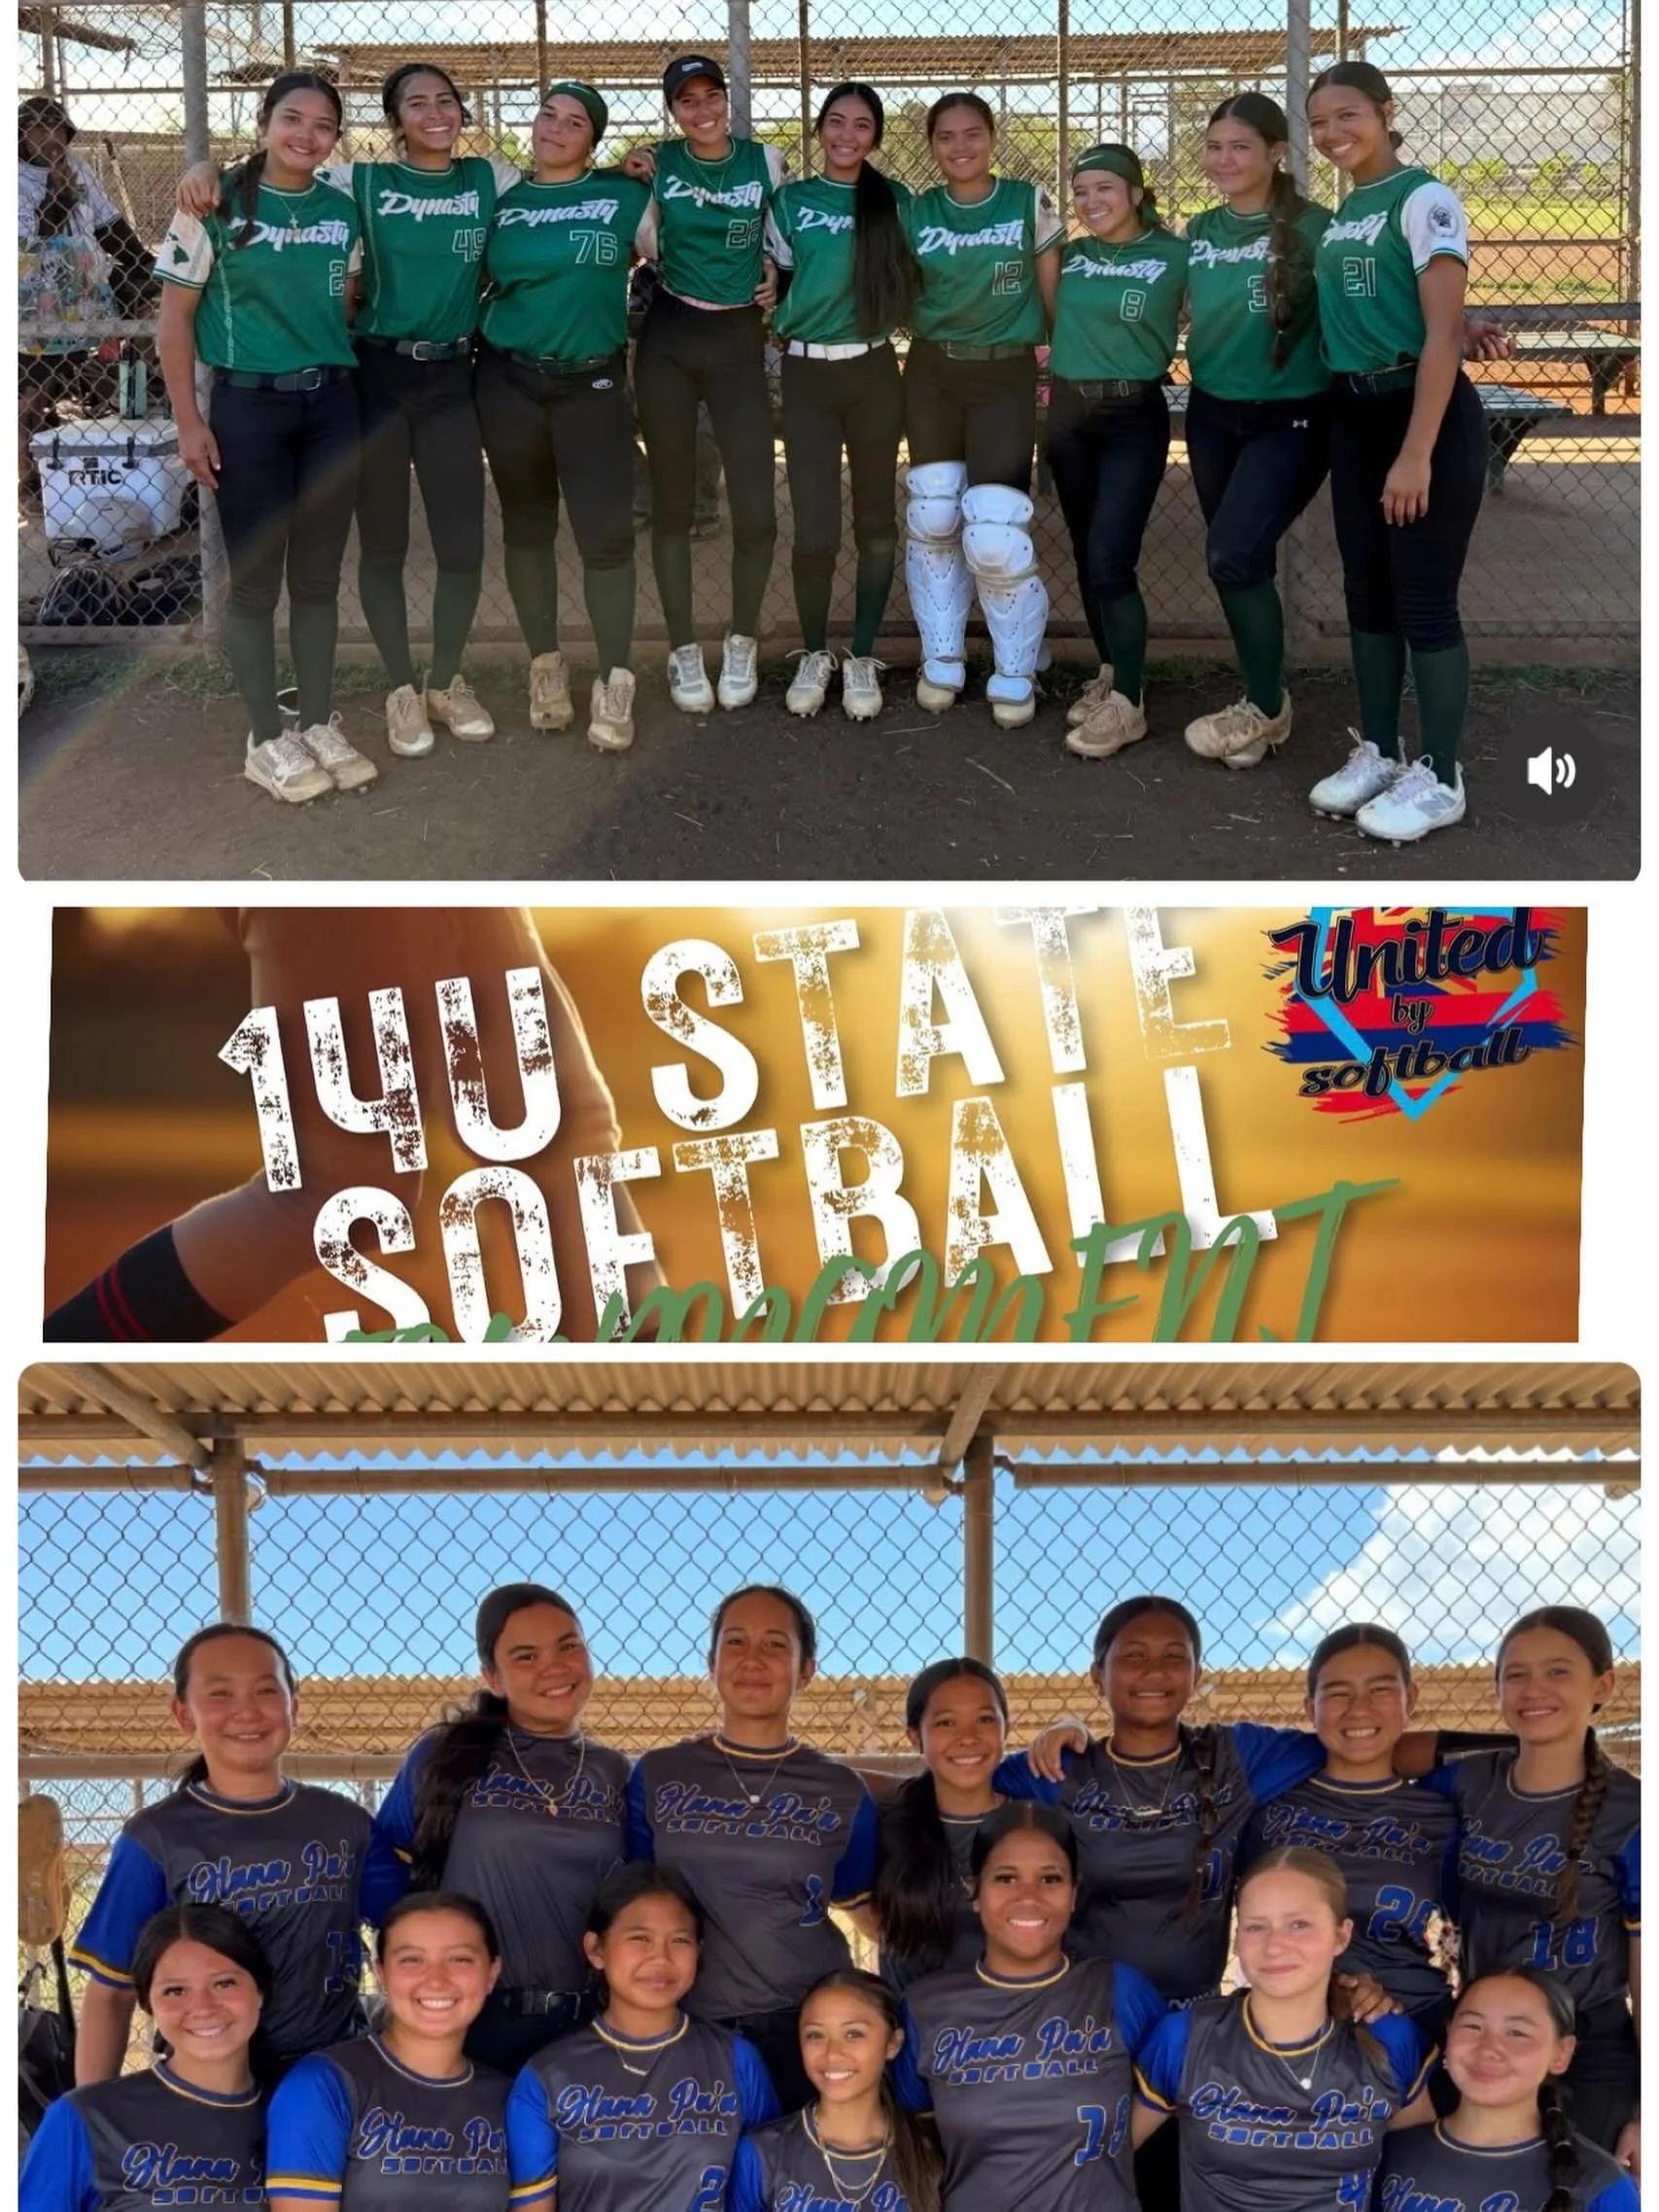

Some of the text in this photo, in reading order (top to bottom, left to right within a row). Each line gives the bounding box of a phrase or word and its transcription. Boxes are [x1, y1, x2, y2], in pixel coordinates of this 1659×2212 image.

[377, 189, 480, 223] Dynasty
[664, 175, 763, 210] Dynasty
[494, 198, 620, 228] Dynasty
[227, 217, 350, 252] Dynasty
[570, 229, 618, 266] 76
[917, 219, 1025, 257] Dynasty
[992, 260, 1024, 296] 12
[1061, 254, 1167, 284] Dynasty
[1342, 257, 1376, 297] 21
[1120, 288, 1148, 323] 8
[1267, 908, 1545, 1004] United
[1392, 993, 1434, 1035] by
[218, 907, 1231, 1192] 14U STATE
[1298, 1025, 1536, 1097] softball
[312, 1065, 1278, 1342] SOFTBALL
[949, 2058, 1098, 2086] SOFTBALL
[577, 2118, 728, 2144] SOFTBALL
[1208, 2122, 1374, 2150] SOFTBALL
[380, 2156, 508, 2175] SOFTBAL
